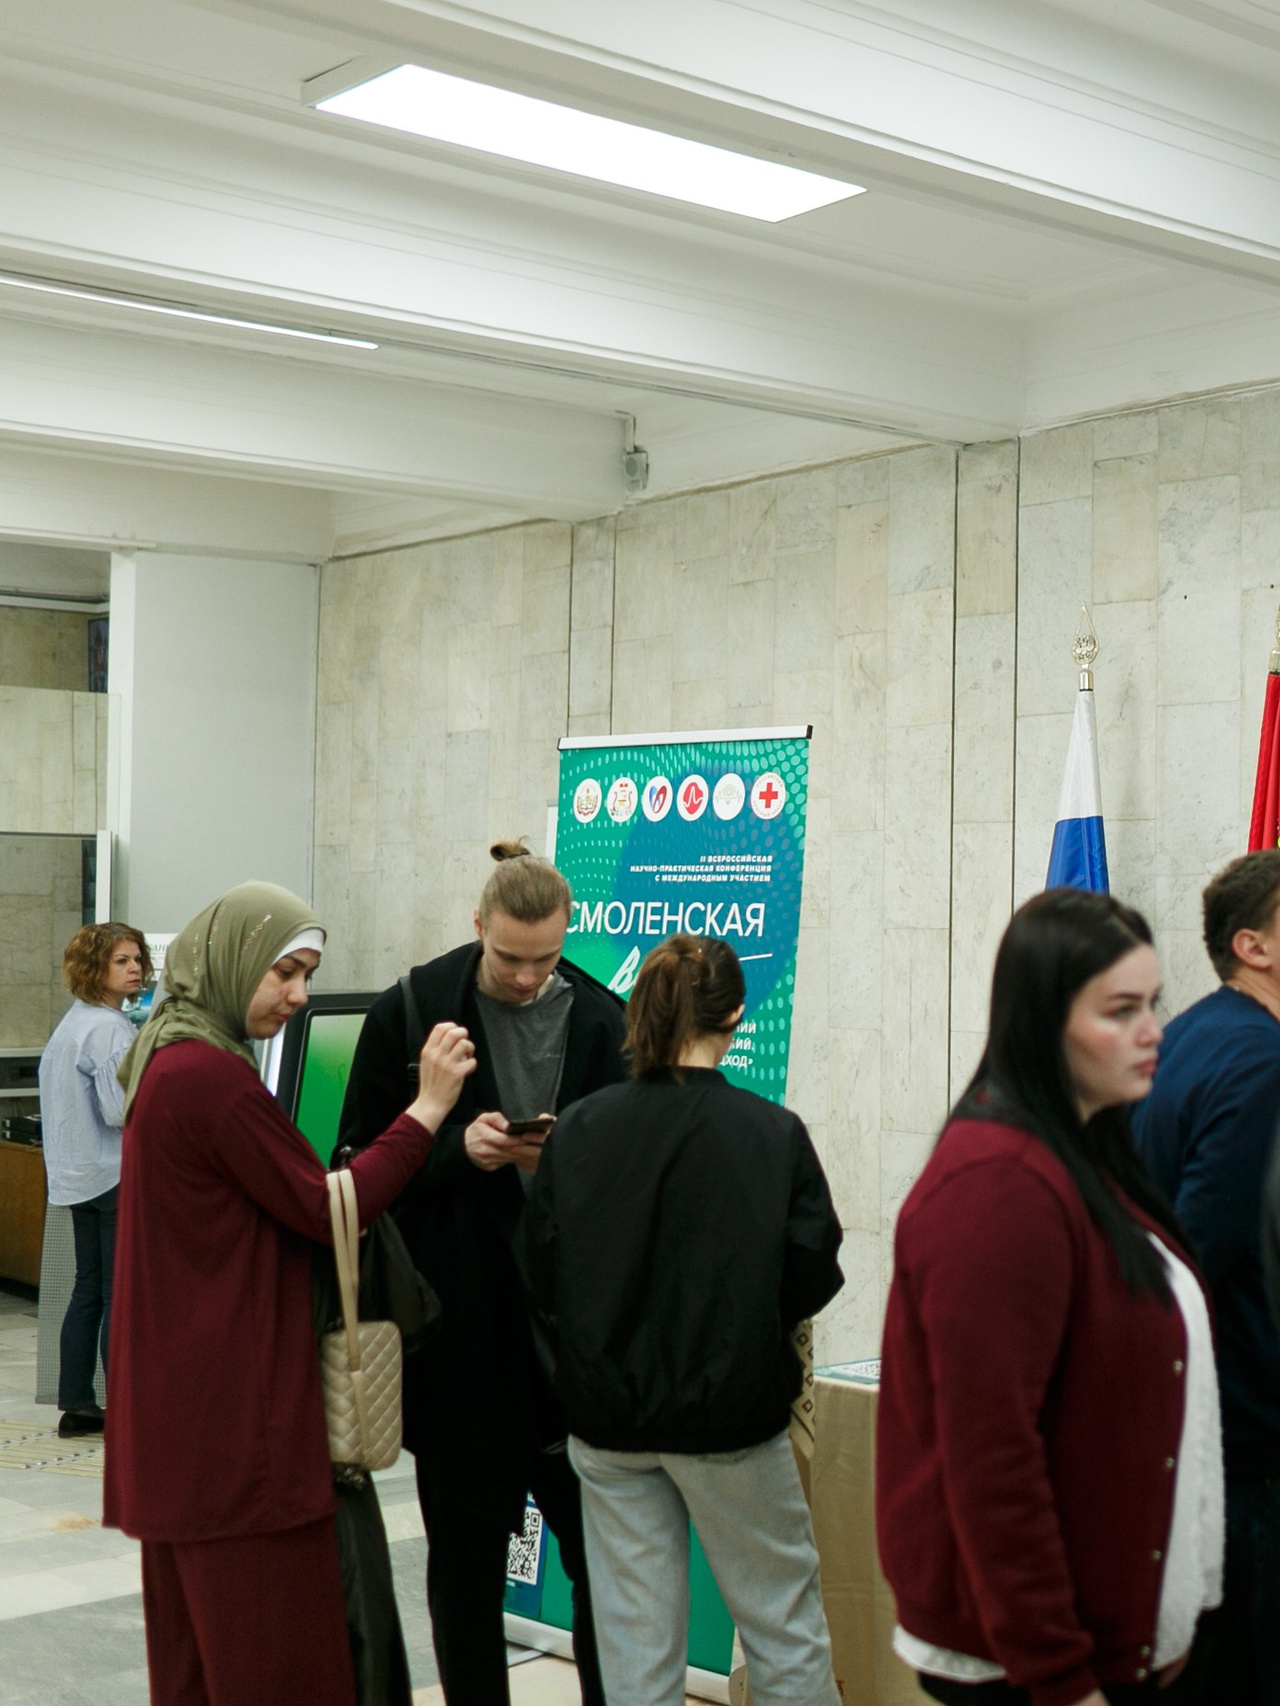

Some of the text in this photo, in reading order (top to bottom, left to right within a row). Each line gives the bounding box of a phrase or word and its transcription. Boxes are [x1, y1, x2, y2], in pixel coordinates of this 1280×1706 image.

[707, 854, 773, 863] ВСЕРОССИЙСКАЯ
[630, 864, 772, 873] НАУЧНО-ПРАКТИЧЕСКАЯ КОНФЕРЕНЦИЯ
[654, 874, 771, 883] С МЕЖДУНАРОДНЫМ УЧАСТИЕМ
